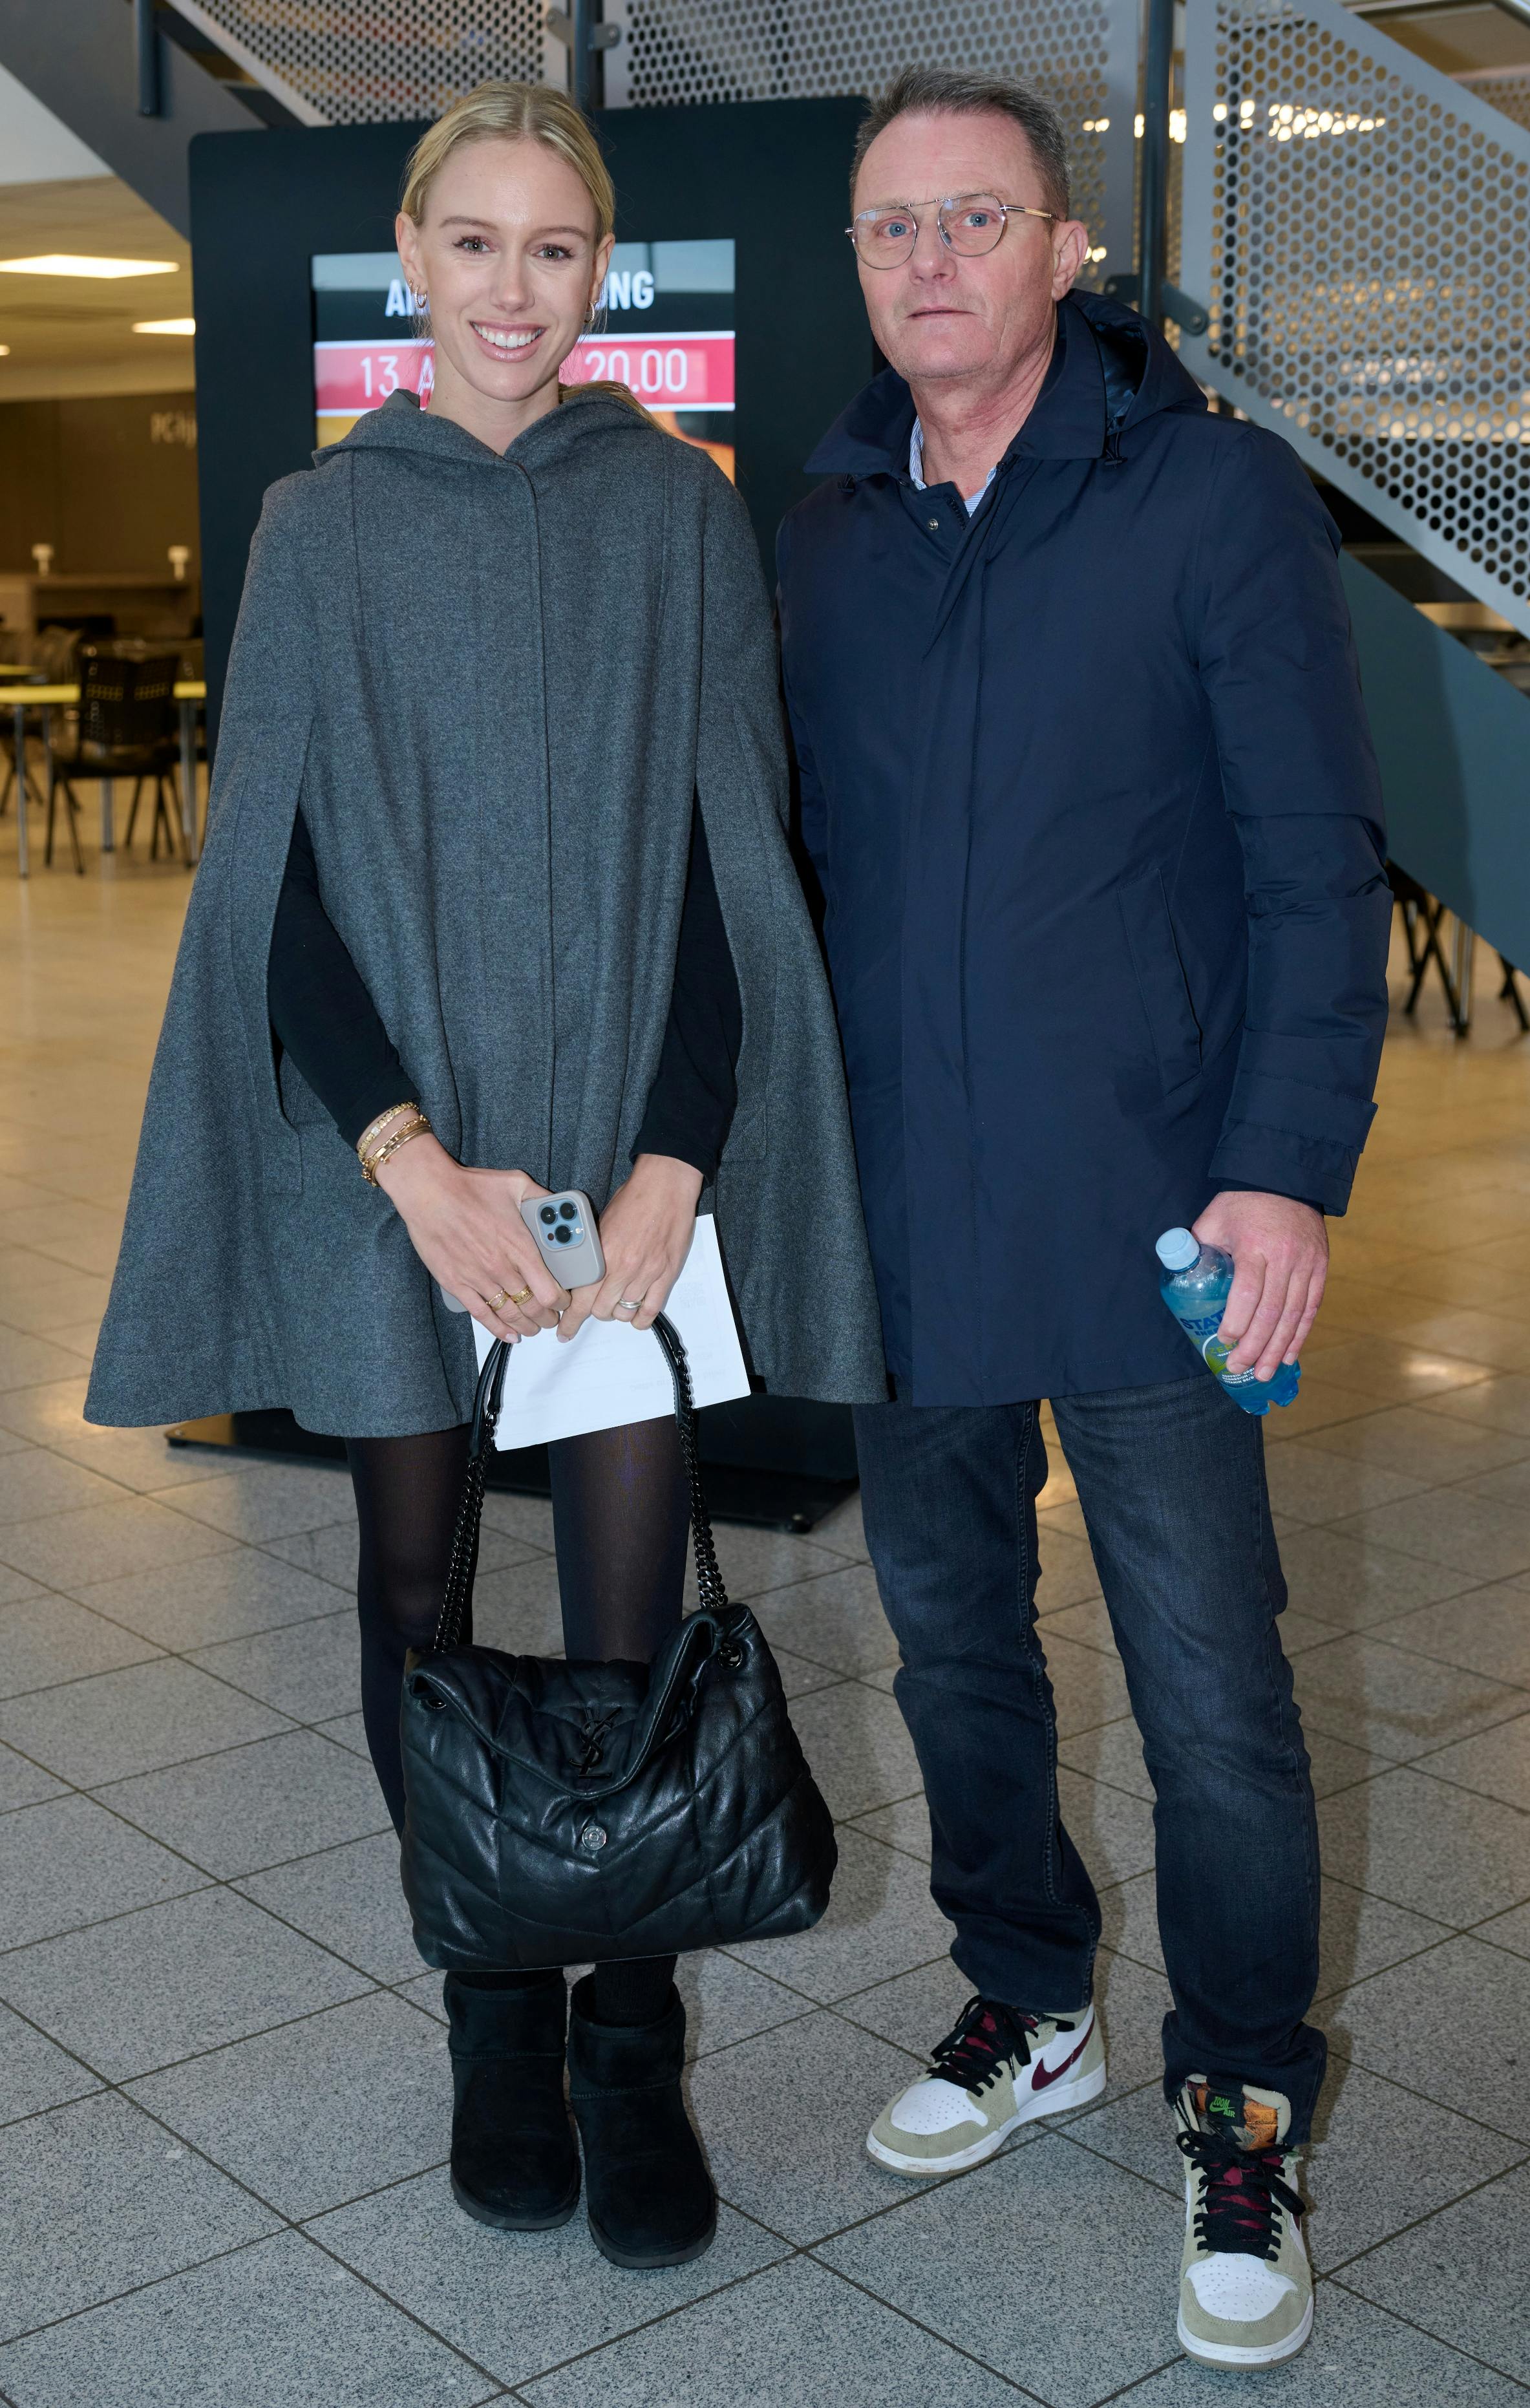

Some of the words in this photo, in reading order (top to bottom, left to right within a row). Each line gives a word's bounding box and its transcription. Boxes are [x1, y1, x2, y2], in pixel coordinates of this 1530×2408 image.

[361, 355, 399, 398] 13
[584, 348, 688, 393] 20.00
[1180, 1306, 1226, 1330] STAT
[1213, 2096, 1230, 2109] ZOOM
[1223, 2109, 1235, 2118] AIR
